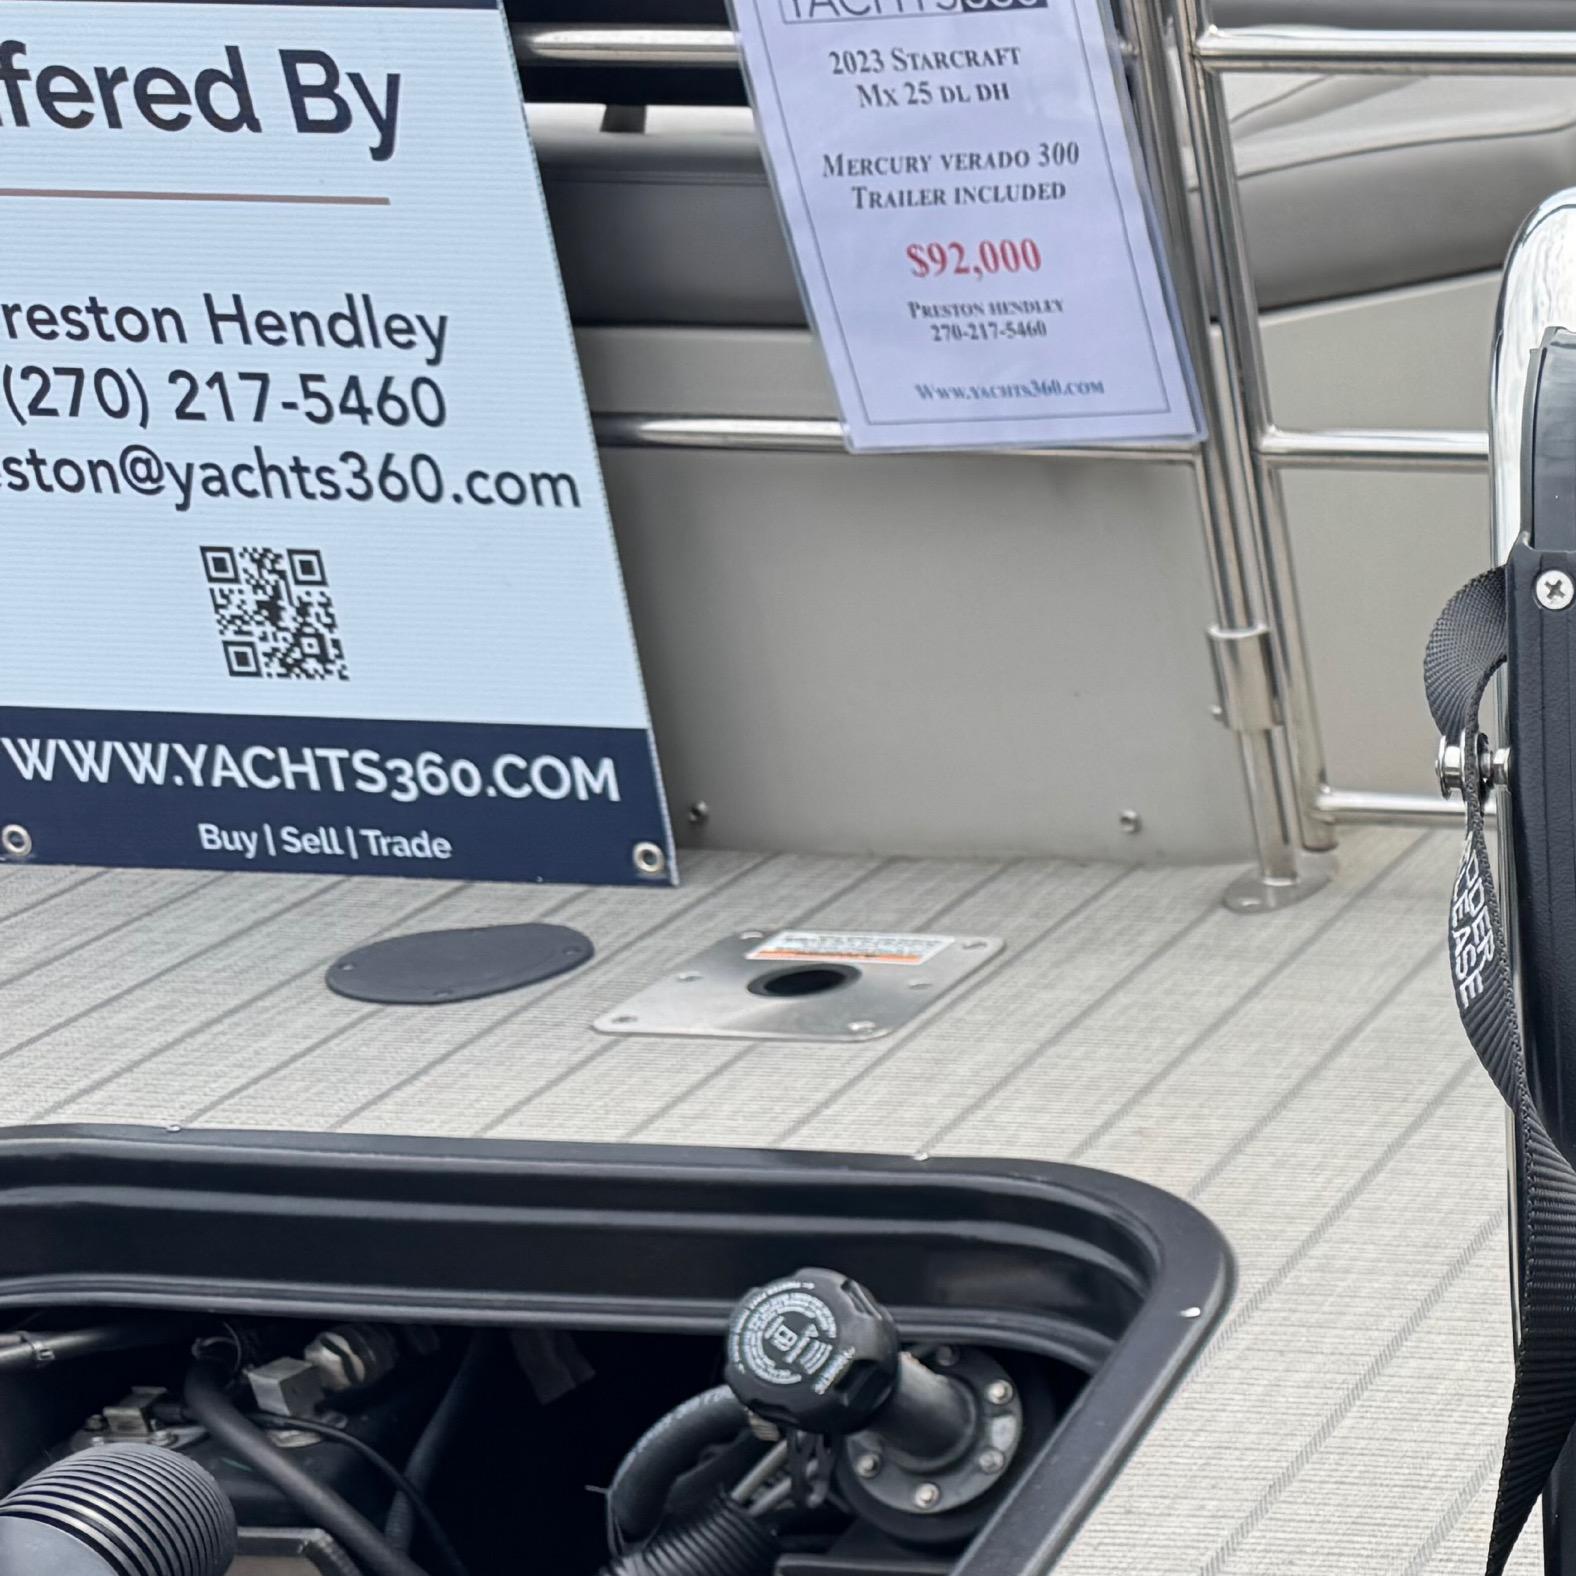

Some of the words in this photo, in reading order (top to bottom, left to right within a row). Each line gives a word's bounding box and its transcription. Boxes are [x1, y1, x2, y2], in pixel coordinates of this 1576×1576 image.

[828, 49, 885, 75] 2023
[0, 40, 263, 133] fered
[279, 48, 402, 162] By
[904, 81, 933, 105] 25
[1038, 141, 1079, 167] 300
[906, 239, 1042, 280] $92,000
[203, 292, 448, 366] Hendley
[930, 320, 1047, 342] 270-217-5460
[3, 364, 149, 430] (270)
[168, 369, 446, 428] 217-5460
[0, 445, 582, 511] ston@yachts360.com
[2, 737, 622, 803] WWW.YACHTS360.COM
[197, 822, 257, 859] Buy
[280, 825, 344, 856] Sell
[360, 829, 453, 859] Trade
